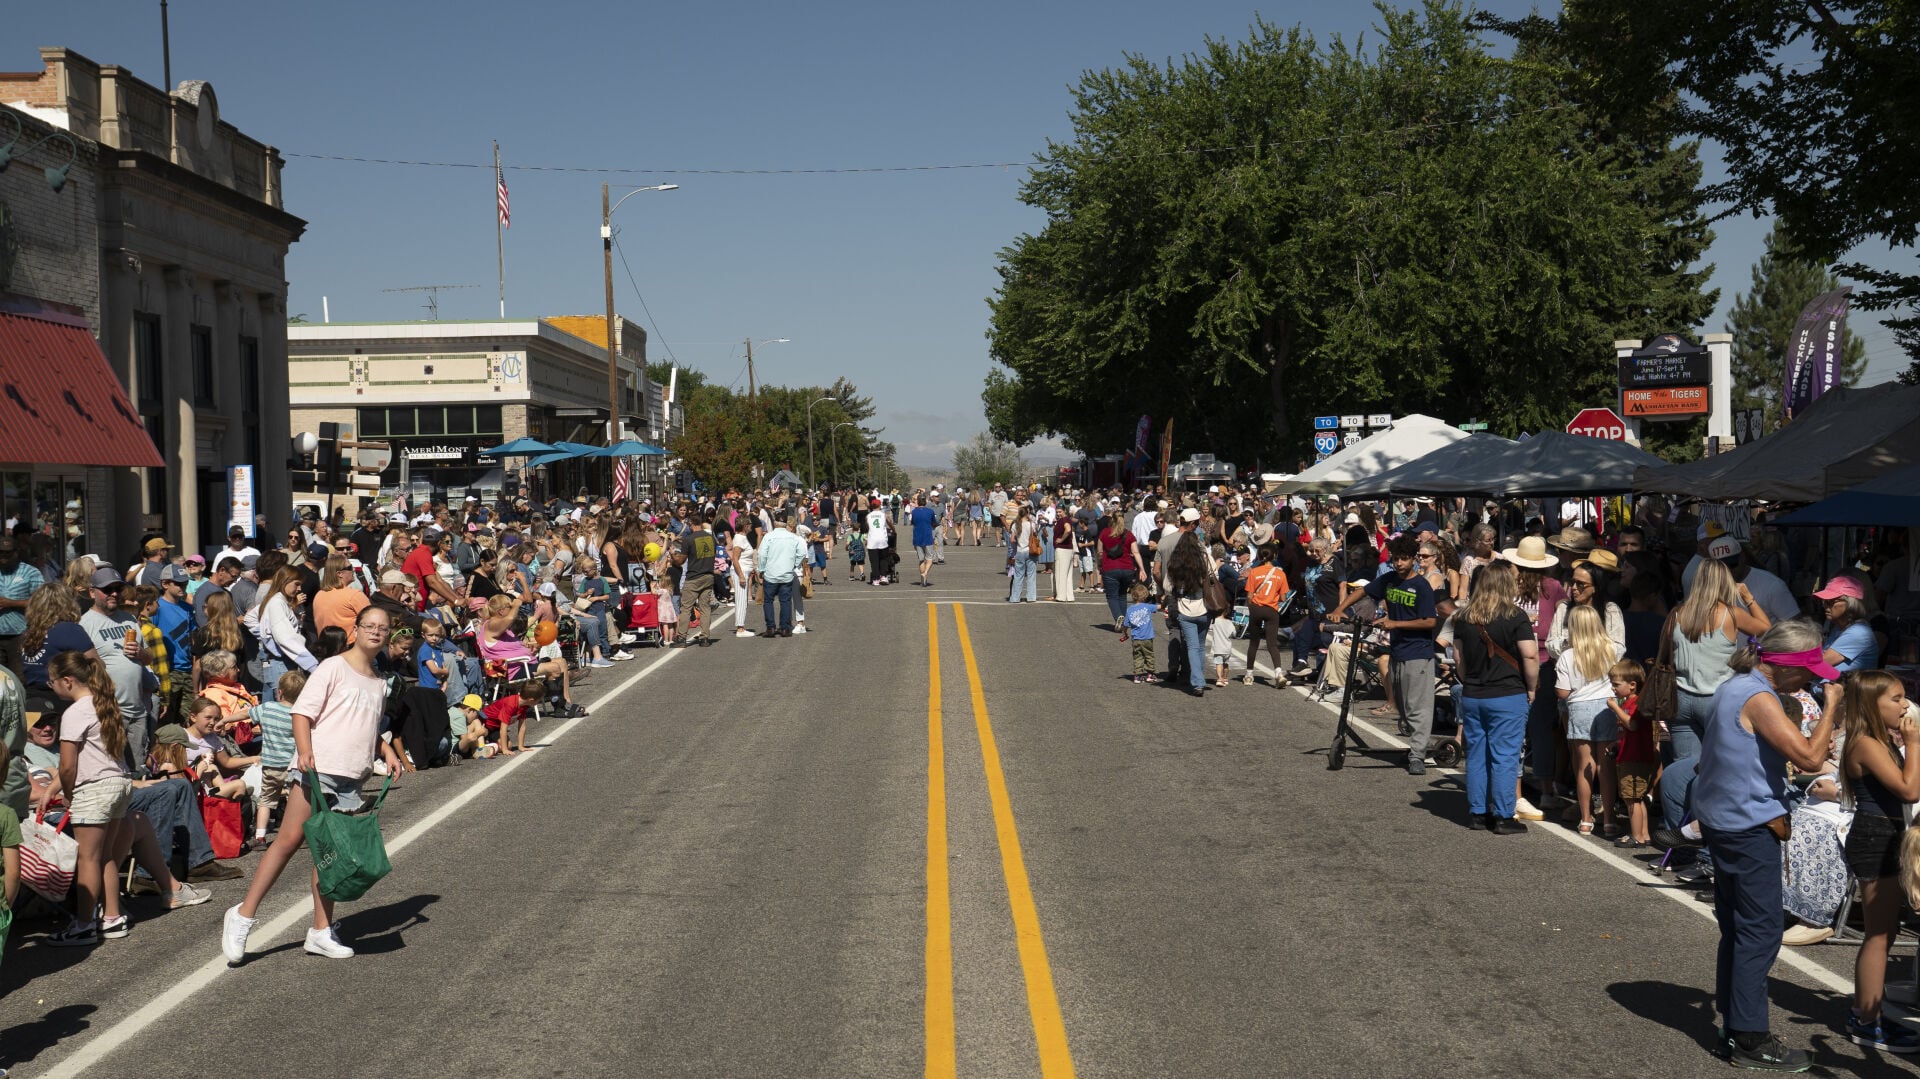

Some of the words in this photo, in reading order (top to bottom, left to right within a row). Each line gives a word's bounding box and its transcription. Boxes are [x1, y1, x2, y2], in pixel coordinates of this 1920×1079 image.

[1628, 391, 1652, 401] HOME
[1348, 417, 1358, 425] TO
[1374, 416, 1386, 424] TO
[1317, 437, 1334, 451] 90
[873, 518, 881, 528] 4
[1712, 545, 1730, 557] 1776
